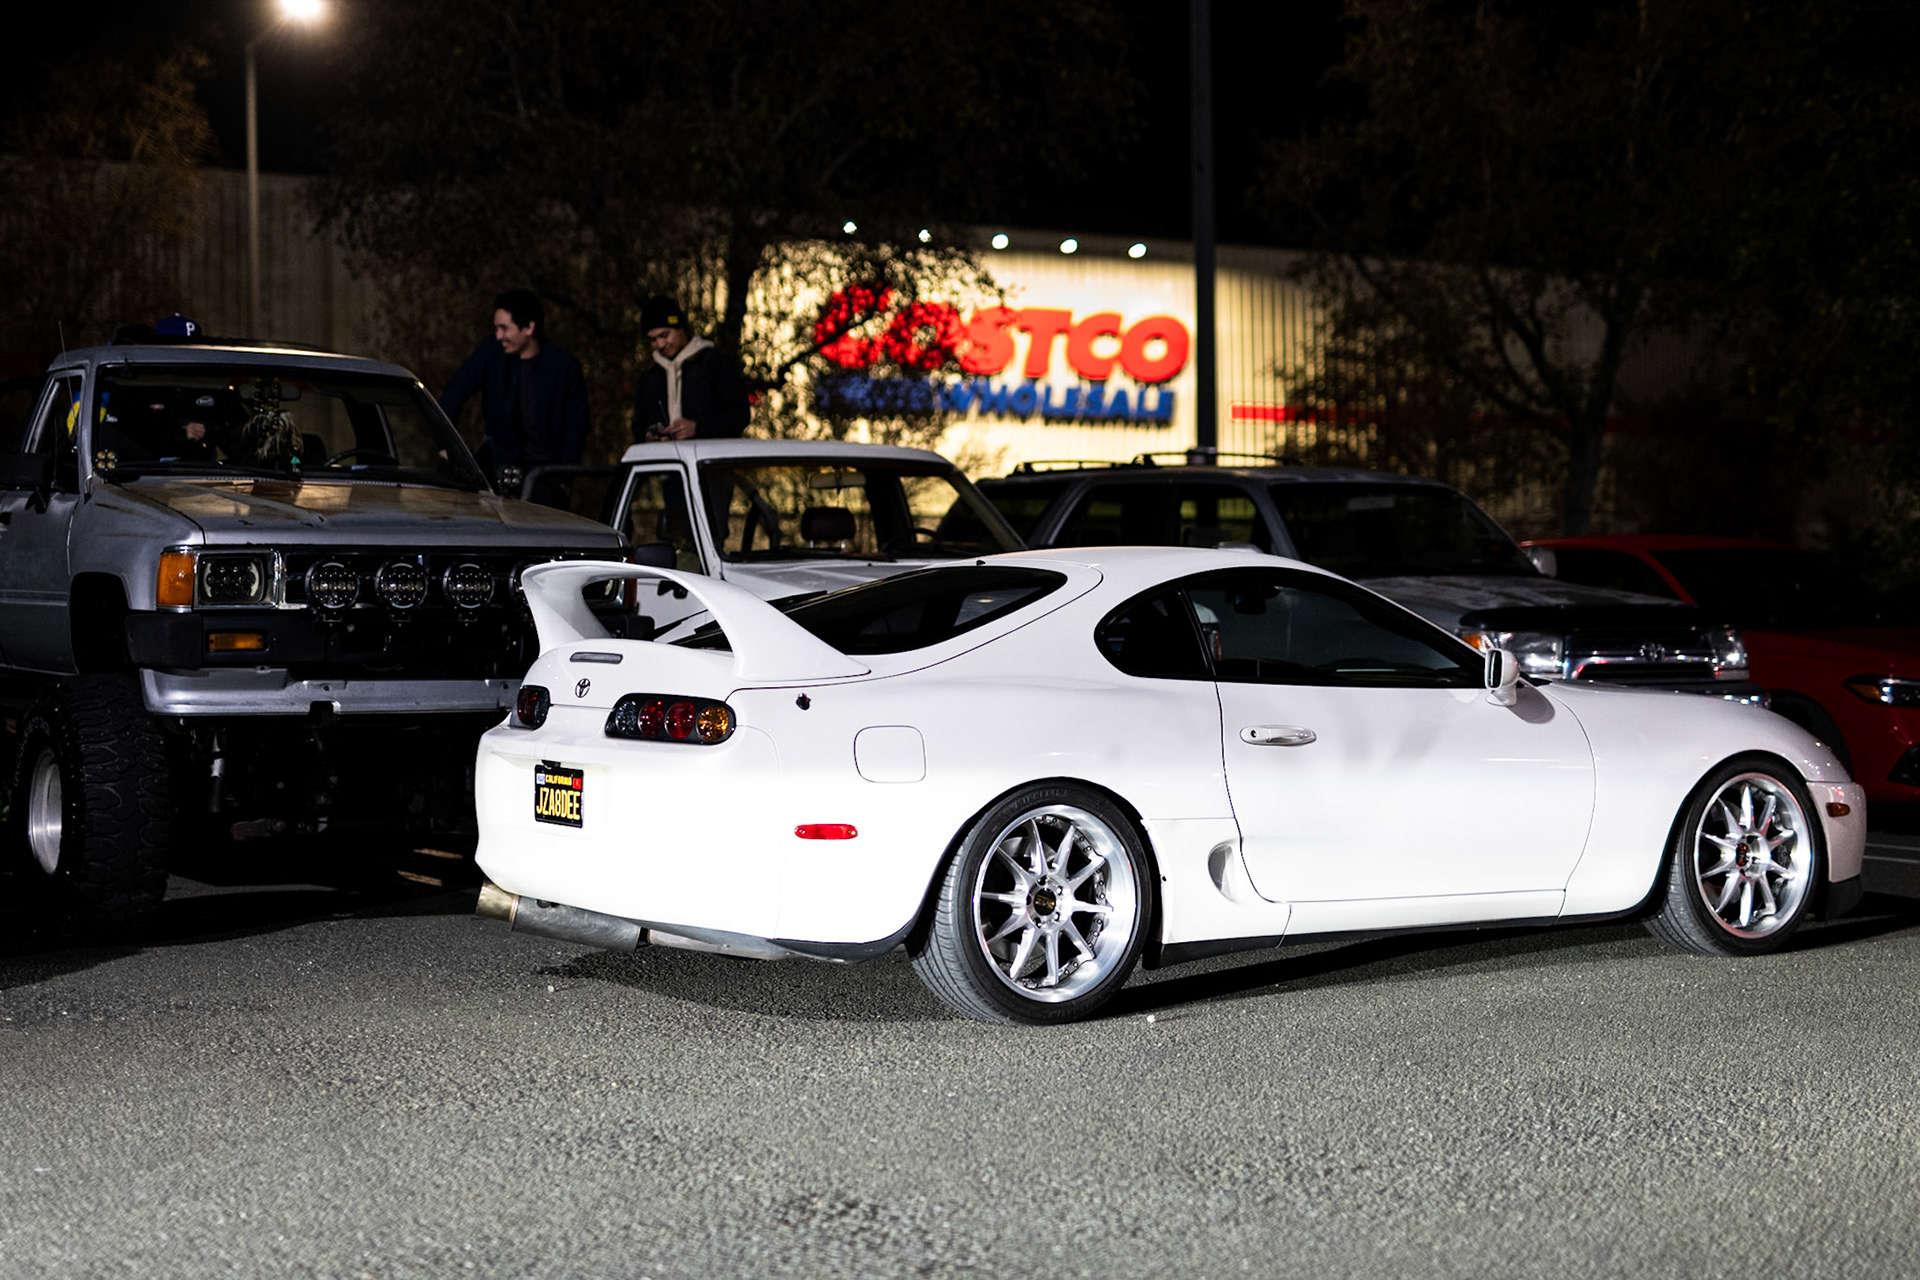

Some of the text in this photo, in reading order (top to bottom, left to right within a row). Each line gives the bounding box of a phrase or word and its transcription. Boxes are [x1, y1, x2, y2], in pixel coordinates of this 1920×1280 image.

[185, 321, 195, 337] P
[939, 380, 1174, 420] WHOLESALE
[545, 774, 572, 786] CALIFORNIA
[536, 787, 581, 820] JZA8DEE
